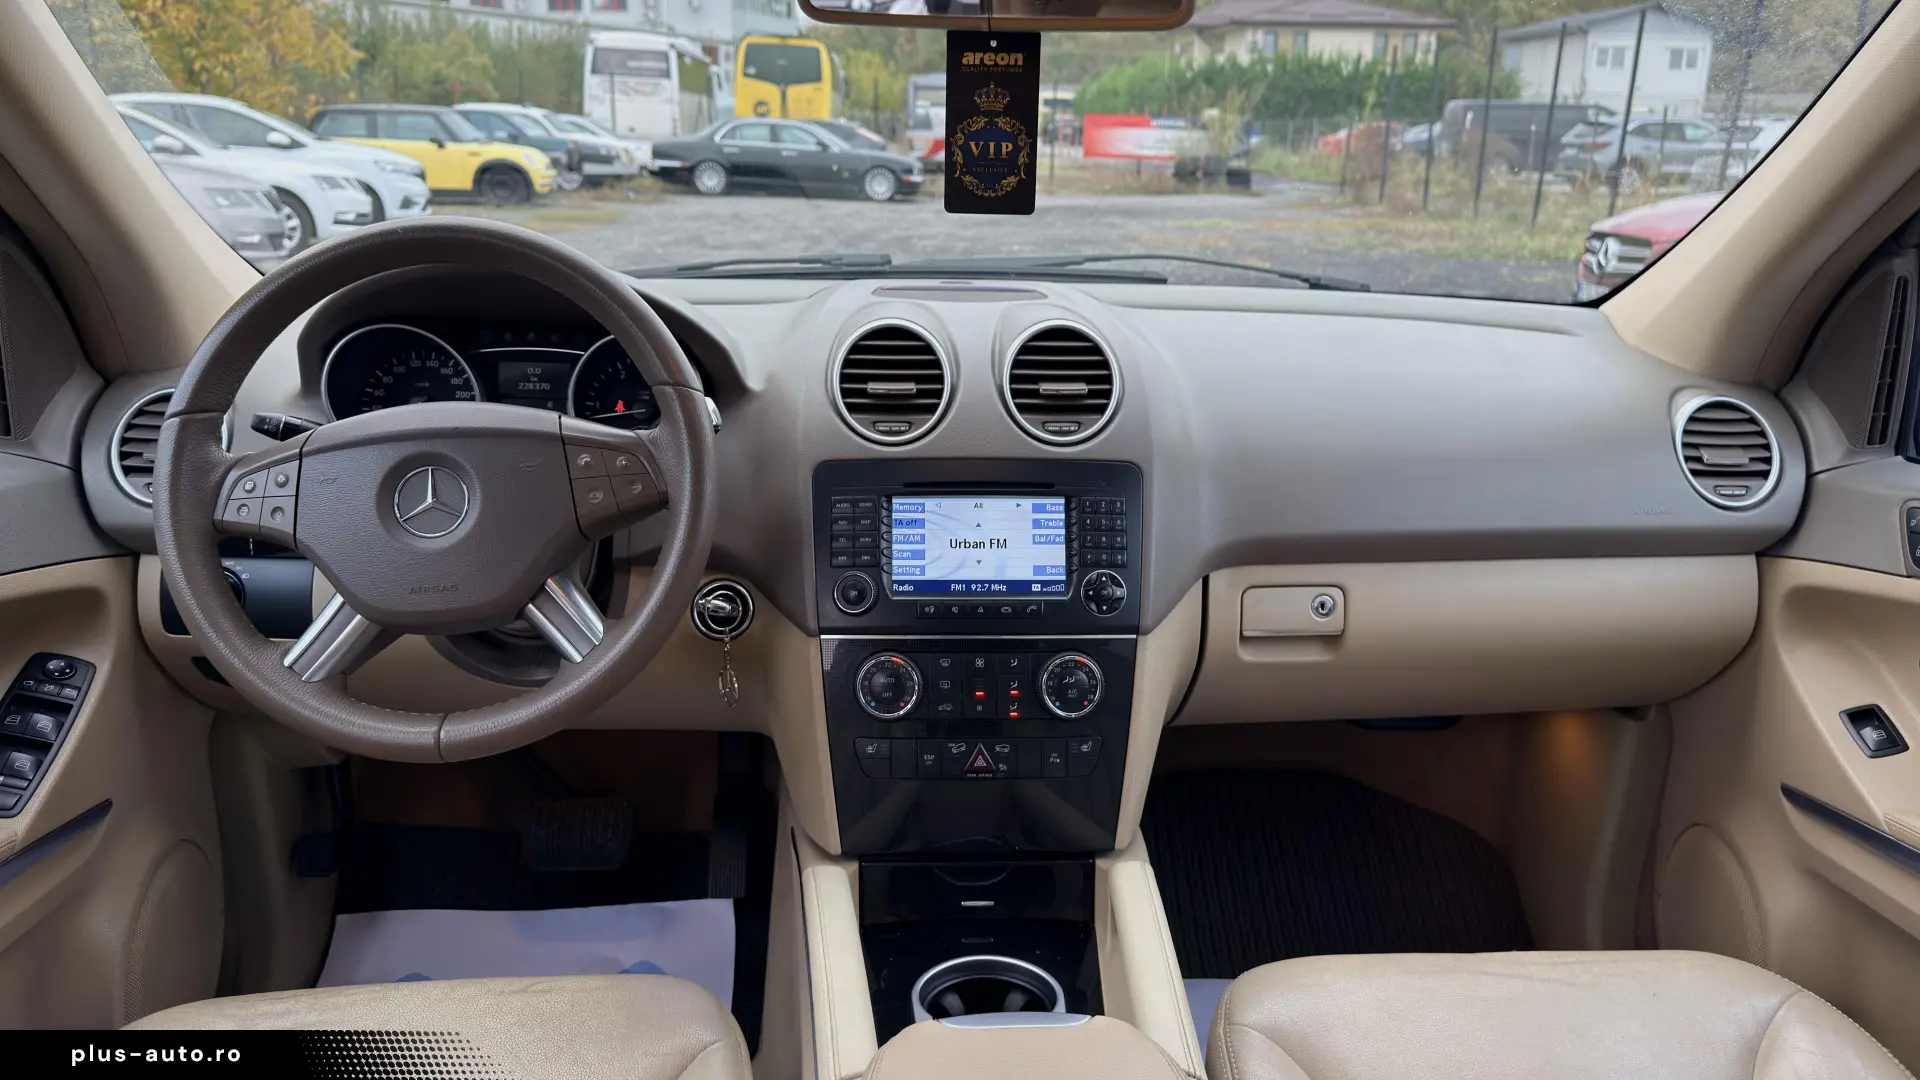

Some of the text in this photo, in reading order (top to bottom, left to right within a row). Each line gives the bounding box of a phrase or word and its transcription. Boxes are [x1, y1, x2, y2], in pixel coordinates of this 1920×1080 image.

[961, 52, 1023, 65] areon
[968, 141, 1013, 159] VIP
[527, 367, 541, 375] 0.0
[456, 391, 471, 399] 200
[893, 503, 923, 512] Memory
[1046, 503, 1064, 511] Bass
[1040, 519, 1064, 527] Treble
[893, 534, 921, 542] FM/AM
[949, 538, 1007, 549] Urban FM
[893, 550, 912, 558] Scan
[893, 566, 921, 575] Setting
[1046, 566, 1064, 574] Back
[991, 584, 1007, 592] MHz
